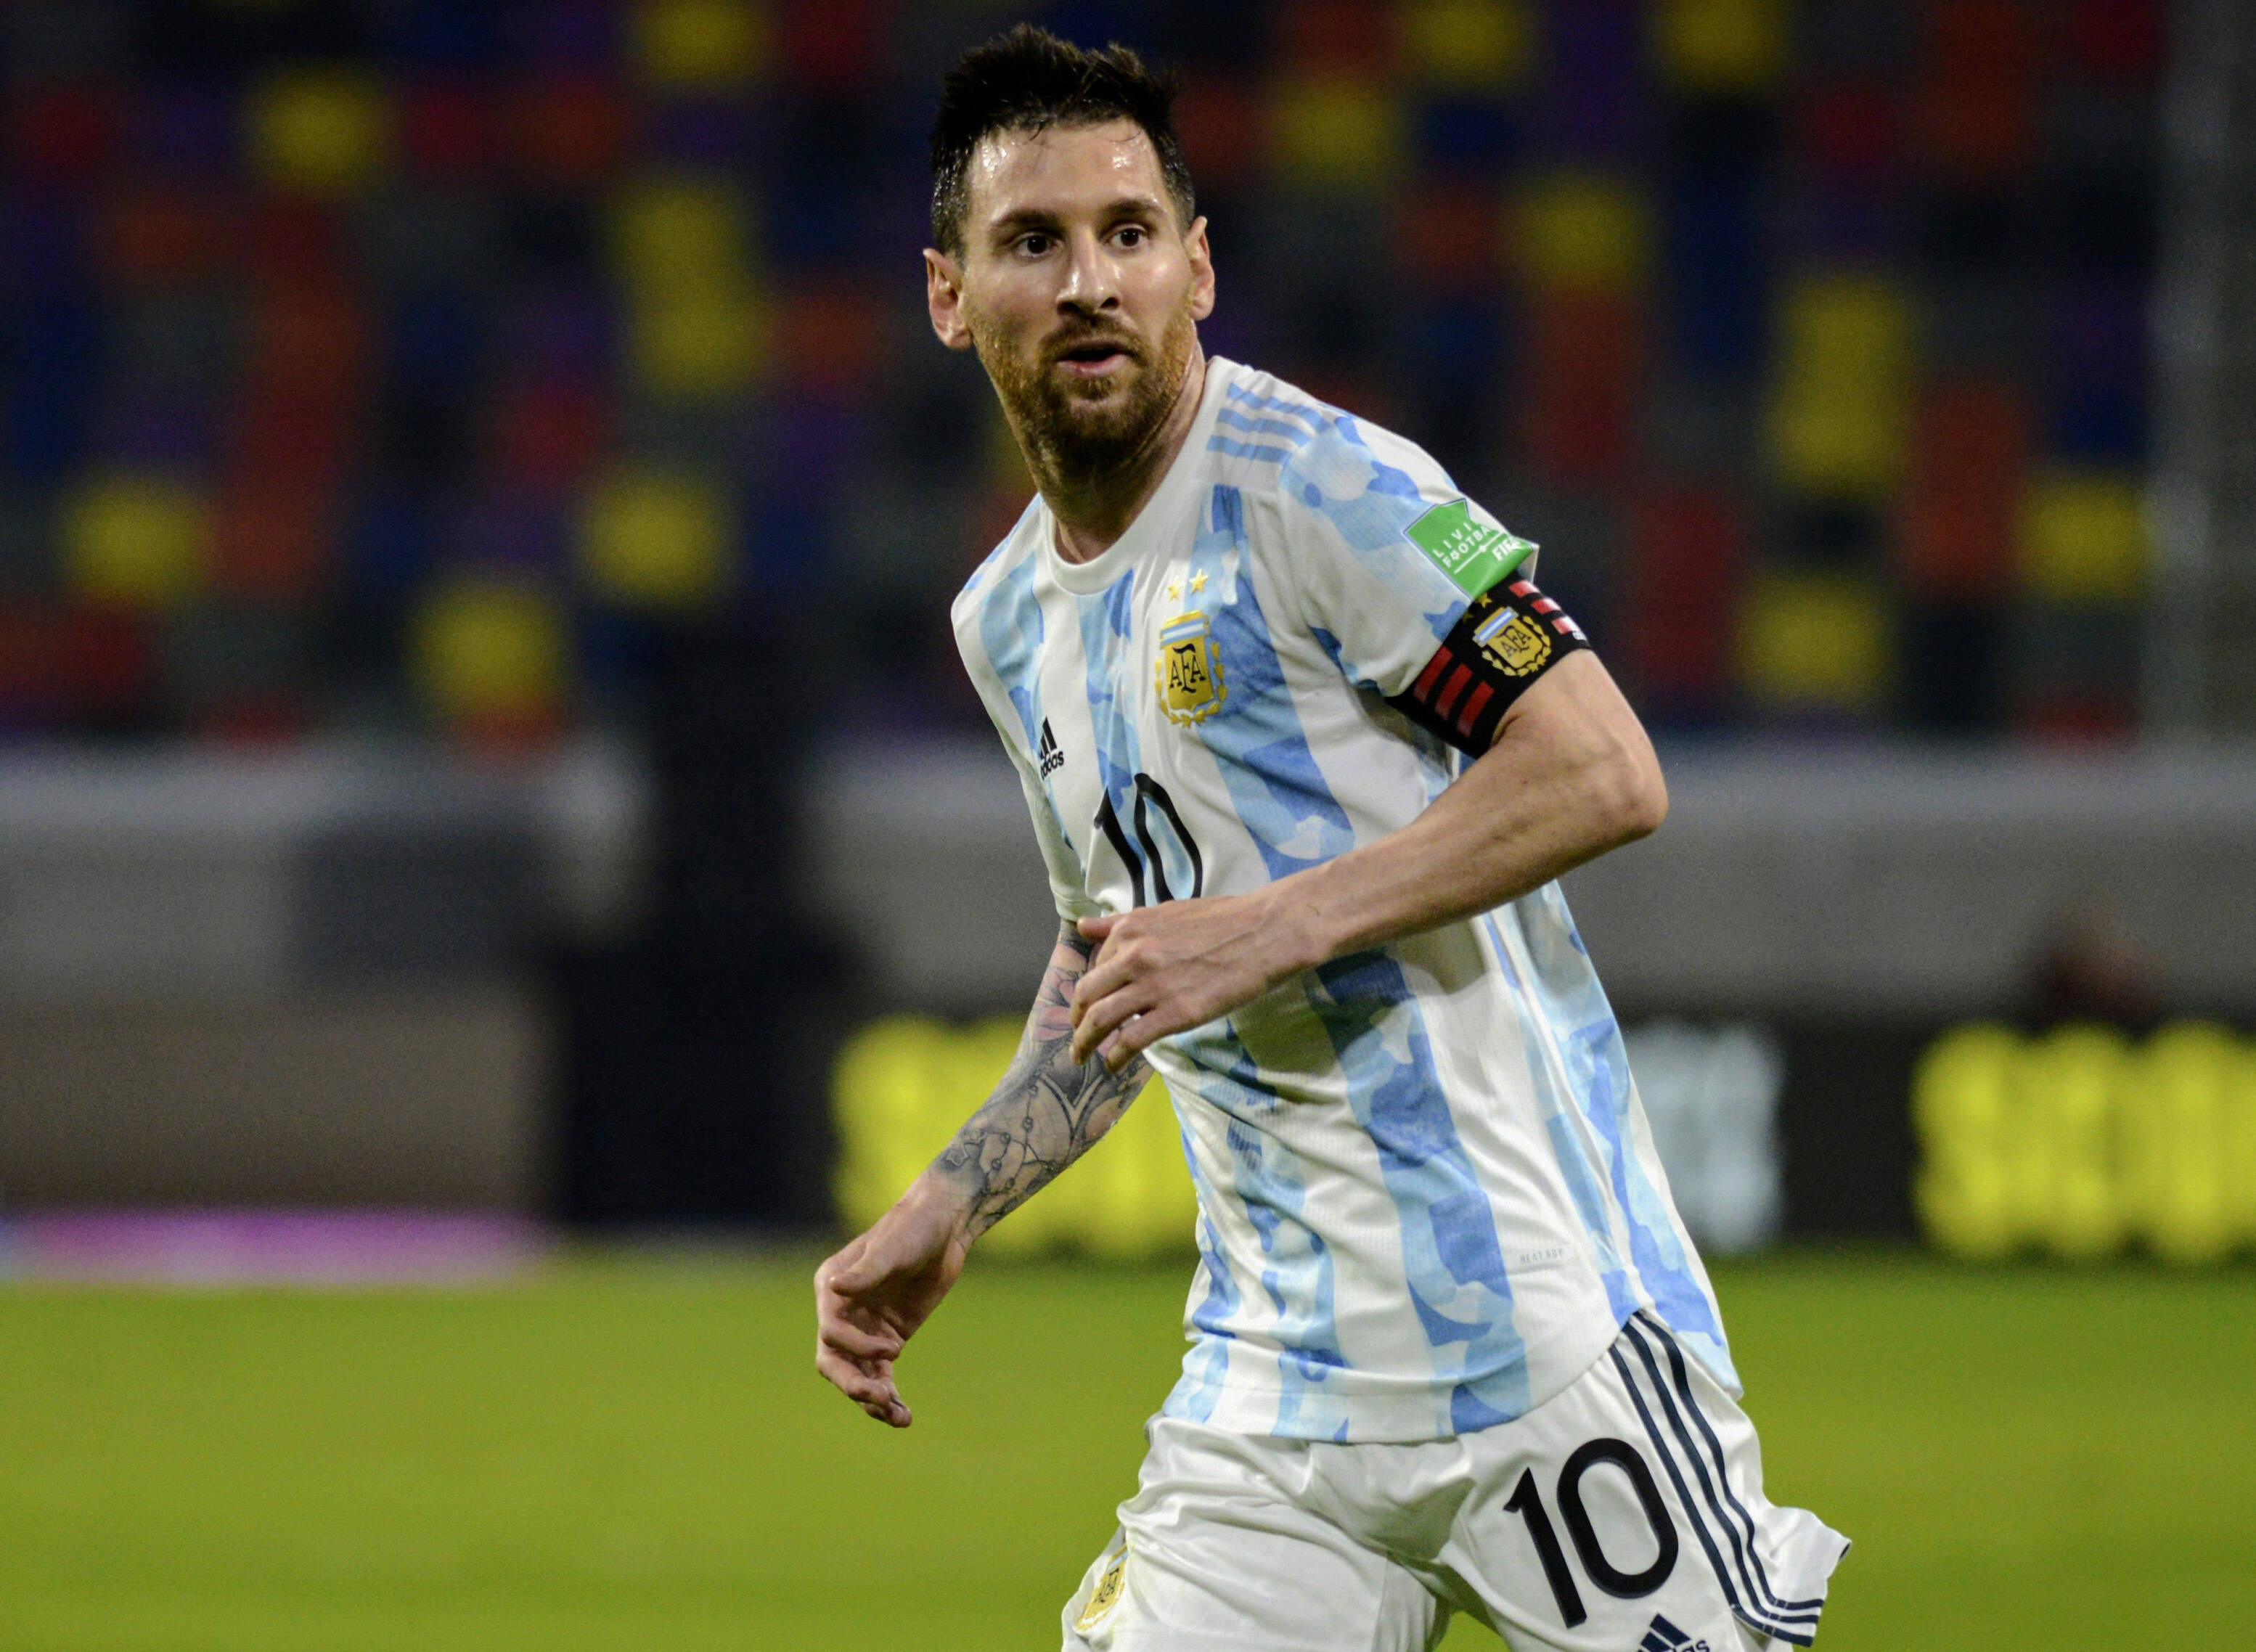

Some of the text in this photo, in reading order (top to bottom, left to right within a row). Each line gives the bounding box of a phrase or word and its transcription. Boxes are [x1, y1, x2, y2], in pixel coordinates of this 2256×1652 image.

[1169, 643, 1206, 694] AFA
[1497, 625, 1532, 658] AFA
[1093, 772, 1203, 909] 10
[1503, 1437, 1679, 1629] 10
